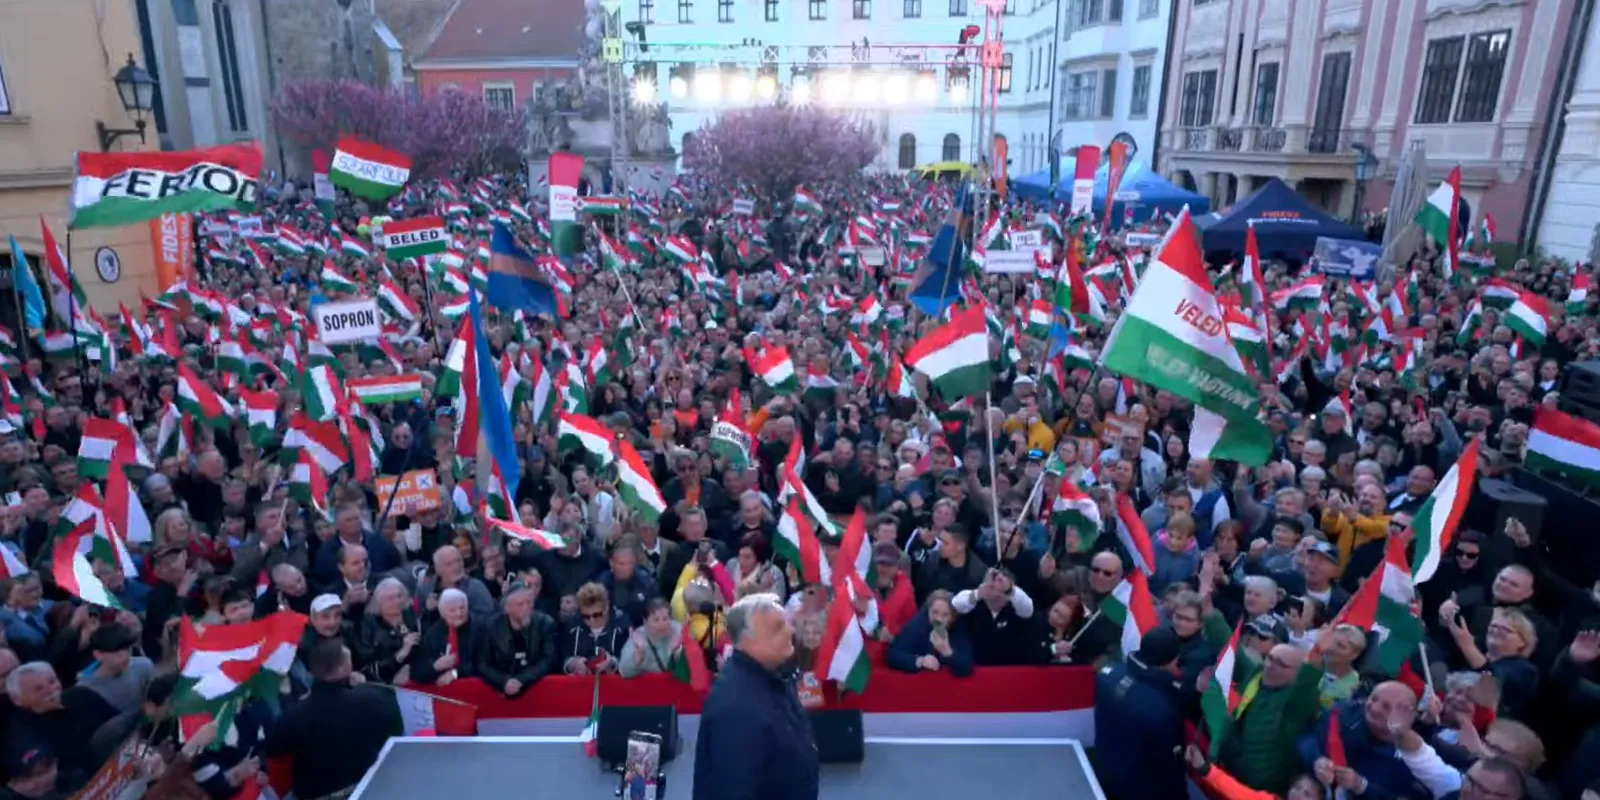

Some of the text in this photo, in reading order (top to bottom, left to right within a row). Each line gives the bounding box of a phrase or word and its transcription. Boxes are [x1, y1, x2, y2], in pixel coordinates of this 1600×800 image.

[161, 211, 178, 263] FIDES
[389, 229, 440, 246] BELED
[322, 309, 375, 331] SOPRON
[1174, 298, 1223, 337] VELED
